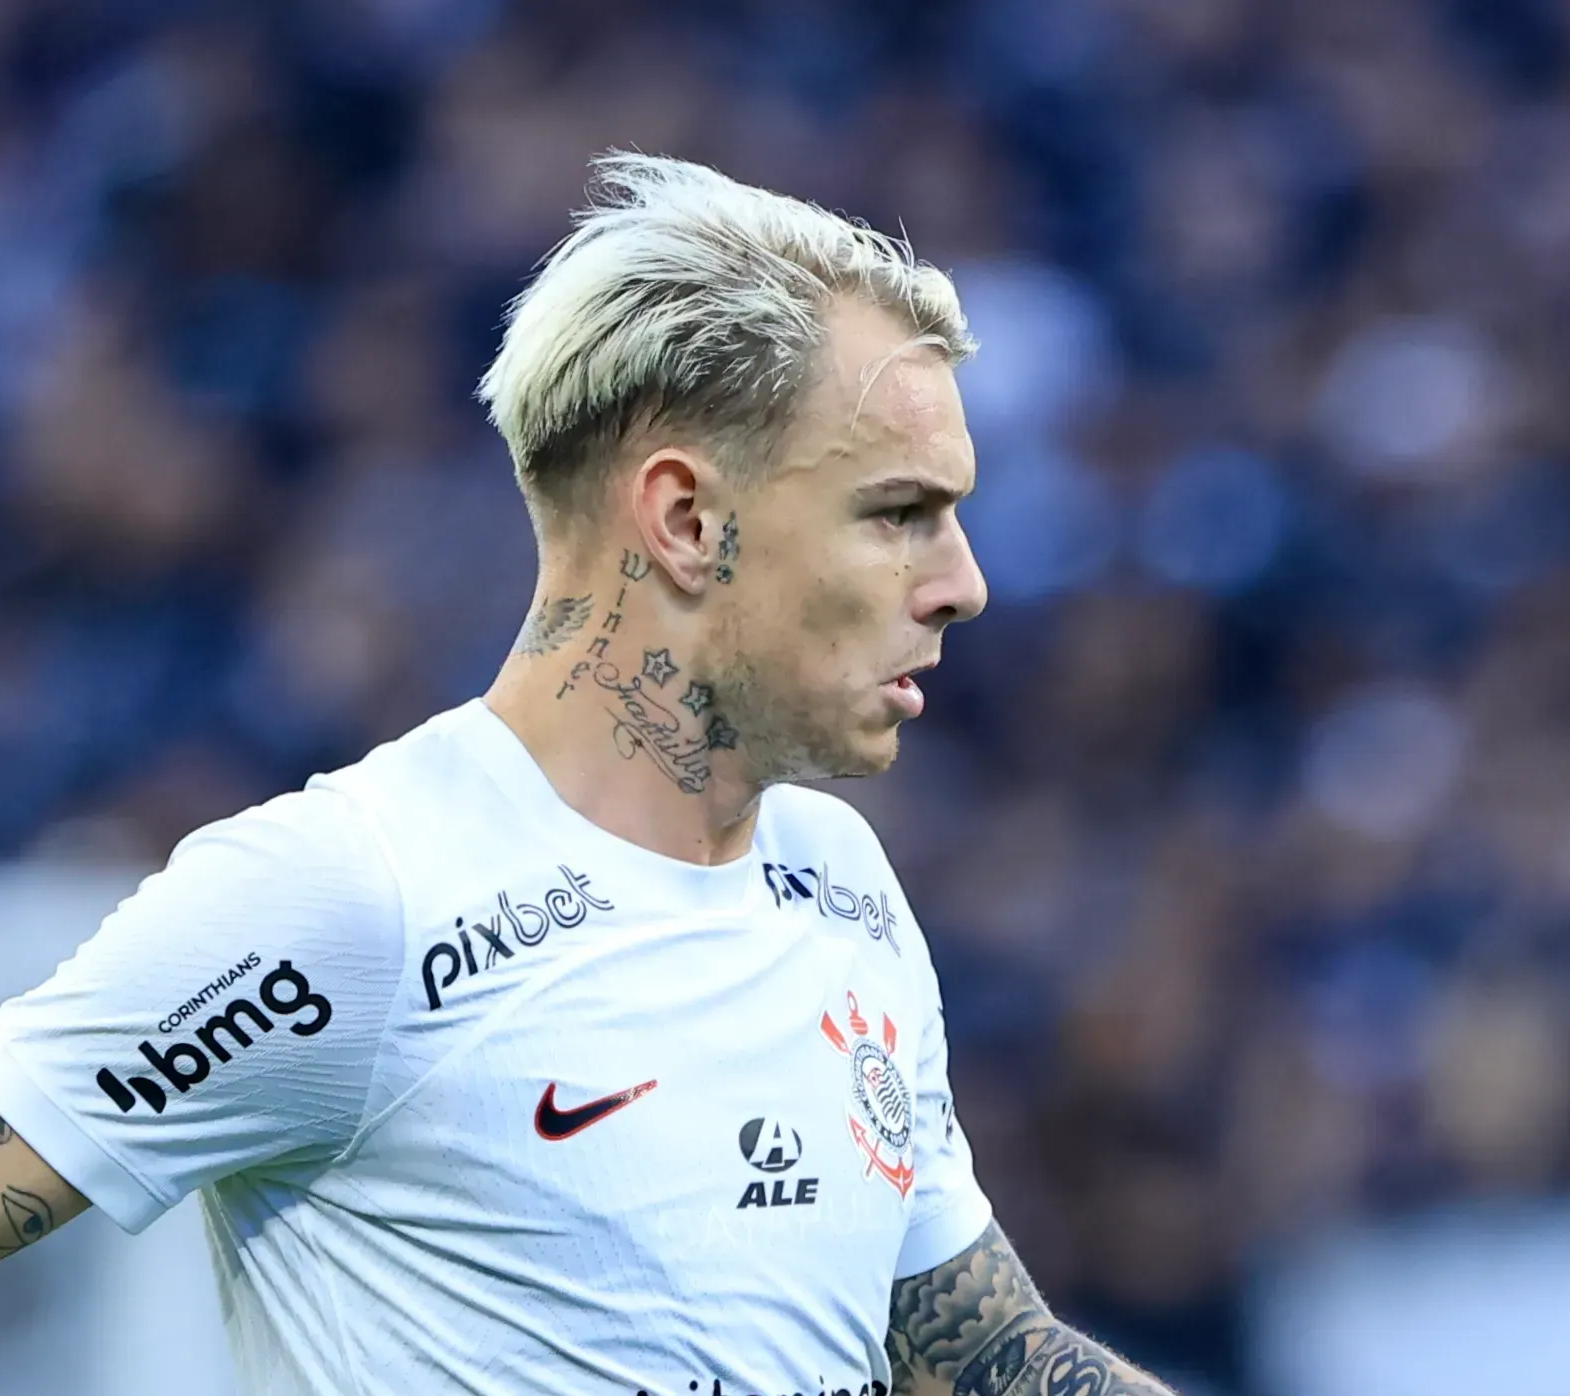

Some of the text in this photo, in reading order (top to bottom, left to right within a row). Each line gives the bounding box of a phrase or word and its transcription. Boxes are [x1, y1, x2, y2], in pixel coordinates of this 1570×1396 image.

[422, 864, 615, 1012] pixbet
[137, 960, 333, 1093] bmg
[158, 952, 262, 1034] CORINTHIANS
[736, 1178, 819, 1209] ALE
